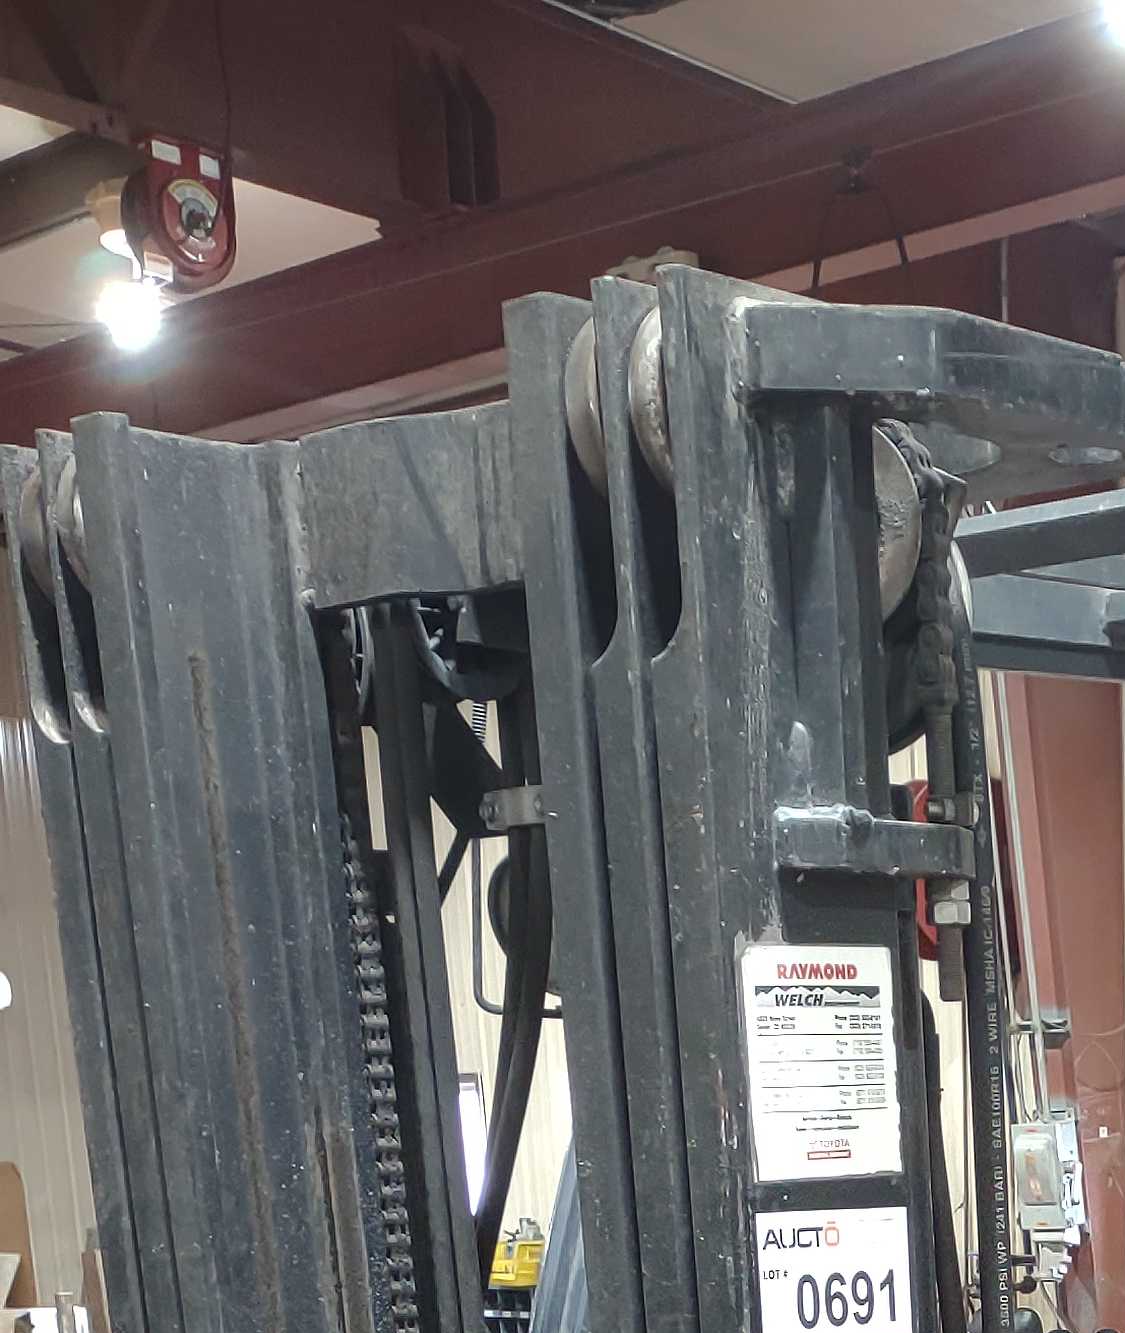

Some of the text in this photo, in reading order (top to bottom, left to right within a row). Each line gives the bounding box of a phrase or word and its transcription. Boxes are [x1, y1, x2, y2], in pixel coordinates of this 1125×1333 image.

[776, 963, 858, 980] RAYMOND
[984, 948, 996, 994] MSHA
[774, 993, 824, 1007] WELCH
[986, 1002, 998, 1041] WIRE
[988, 1046, 999, 1055] 2
[996, 1241, 1008, 1264] WP
[763, 1269, 780, 1280] LOT
[998, 1268, 1009, 1291] PSI
[796, 1268, 897, 1330] 0691
